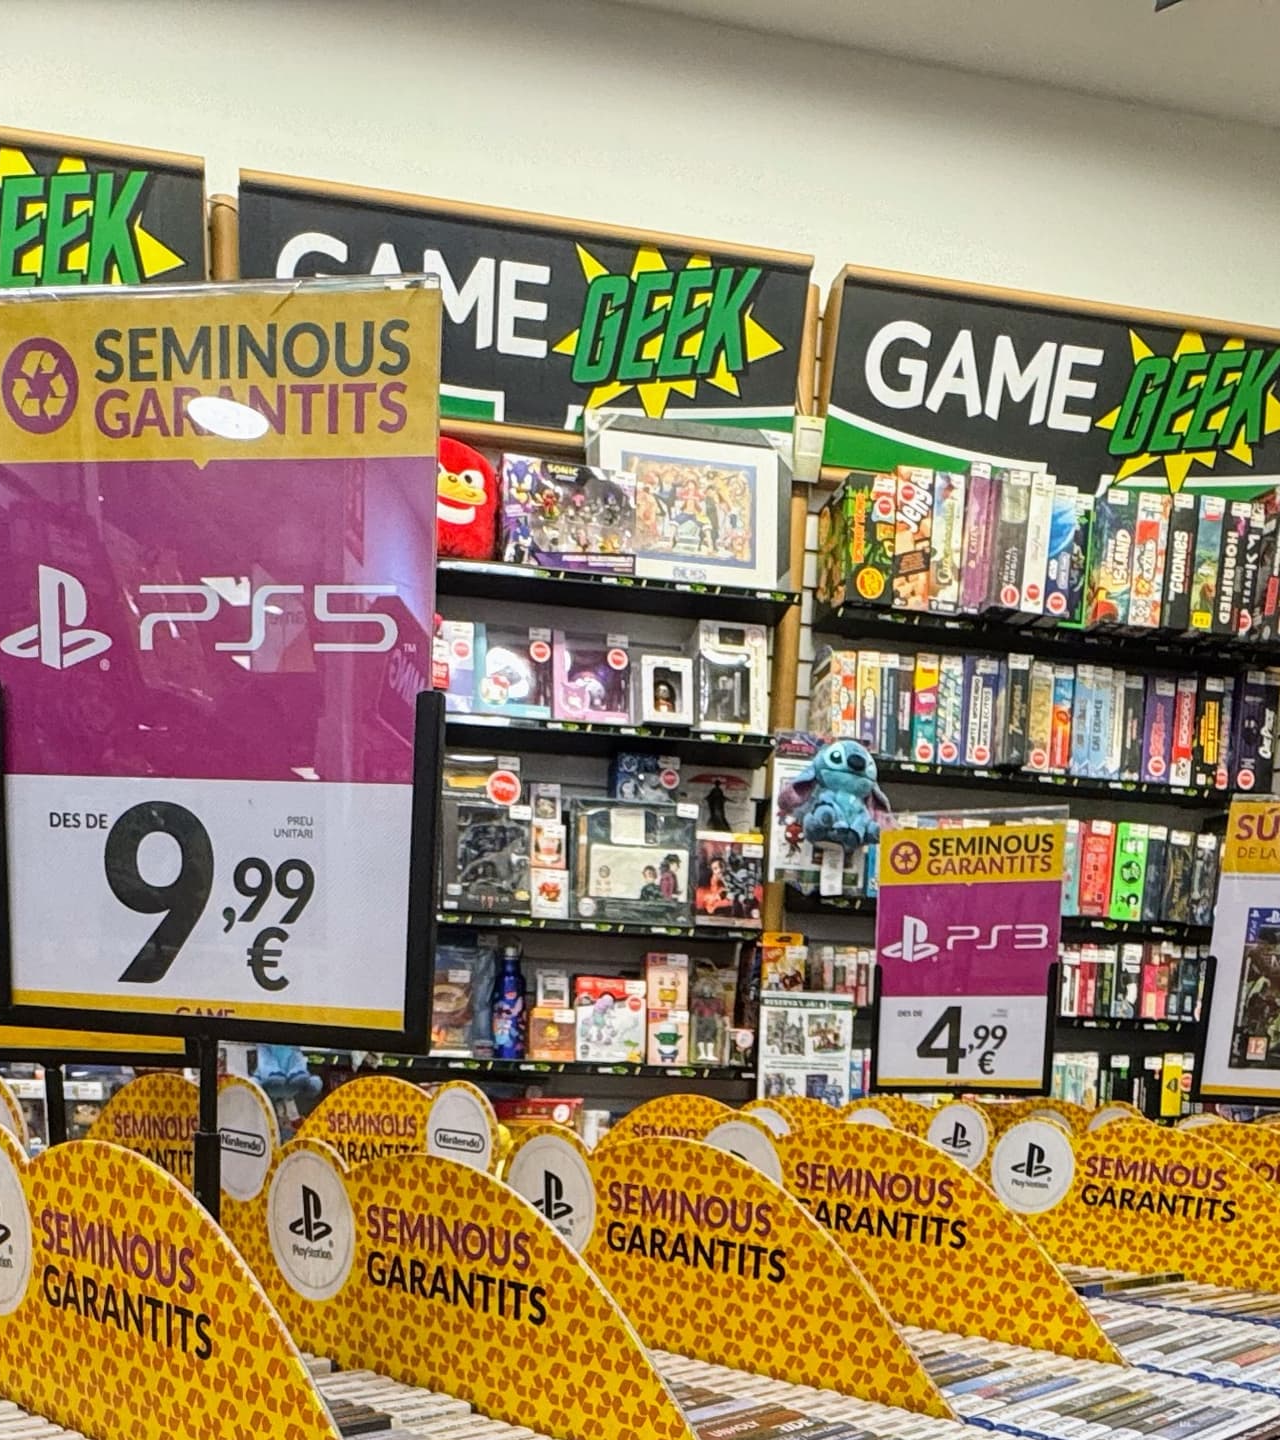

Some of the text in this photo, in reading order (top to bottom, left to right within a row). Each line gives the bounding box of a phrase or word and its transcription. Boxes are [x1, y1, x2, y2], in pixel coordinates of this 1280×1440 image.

[572, 267, 762, 384] GEEK
[94, 319, 411, 383] SEMINOUS
[865, 320, 1105, 433] GAME
[1112, 528, 1132, 586] ISLAND
[1219, 530, 1239, 624] HORRIFIED
[139, 583, 399, 653] PS5
[49, 812, 108, 829] DES DE
[273, 828, 313, 840] UNITARI
[286, 816, 313, 826] PREU
[927, 853, 1053, 876] GARANTITS
[928, 834, 1054, 856] SEMINOUS
[1237, 847, 1256, 858] DE
[1260, 848, 1277, 859] LA
[947, 924, 1049, 950] PS3
[246, 926, 290, 992] €
[977, 1051, 995, 1075] €
[1249, 1039, 1266, 1055] 12
[220, 1130, 266, 1156] Nintendo
[326, 1112, 418, 1138] SEMINOUS
[437, 1131, 485, 1152] Nintendo
[795, 1160, 954, 1210] SEMINOUS
[1010, 1177, 1049, 1189] PlayStation
[1085, 1154, 1228, 1193] SEMINOUS
[608, 1180, 773, 1237] SEMINOUS
[1080, 1183, 1237, 1224] GARANTITS
[40, 1208, 196, 1294] SEMINOUS
[292, 1243, 334, 1261] PlayStation
[367, 1203, 532, 1271] SEMINOUS
[607, 1221, 787, 1284] GARANTITS
[367, 1252, 548, 1326] GARANTITS
[42, 1264, 213, 1360] GARANTITS
